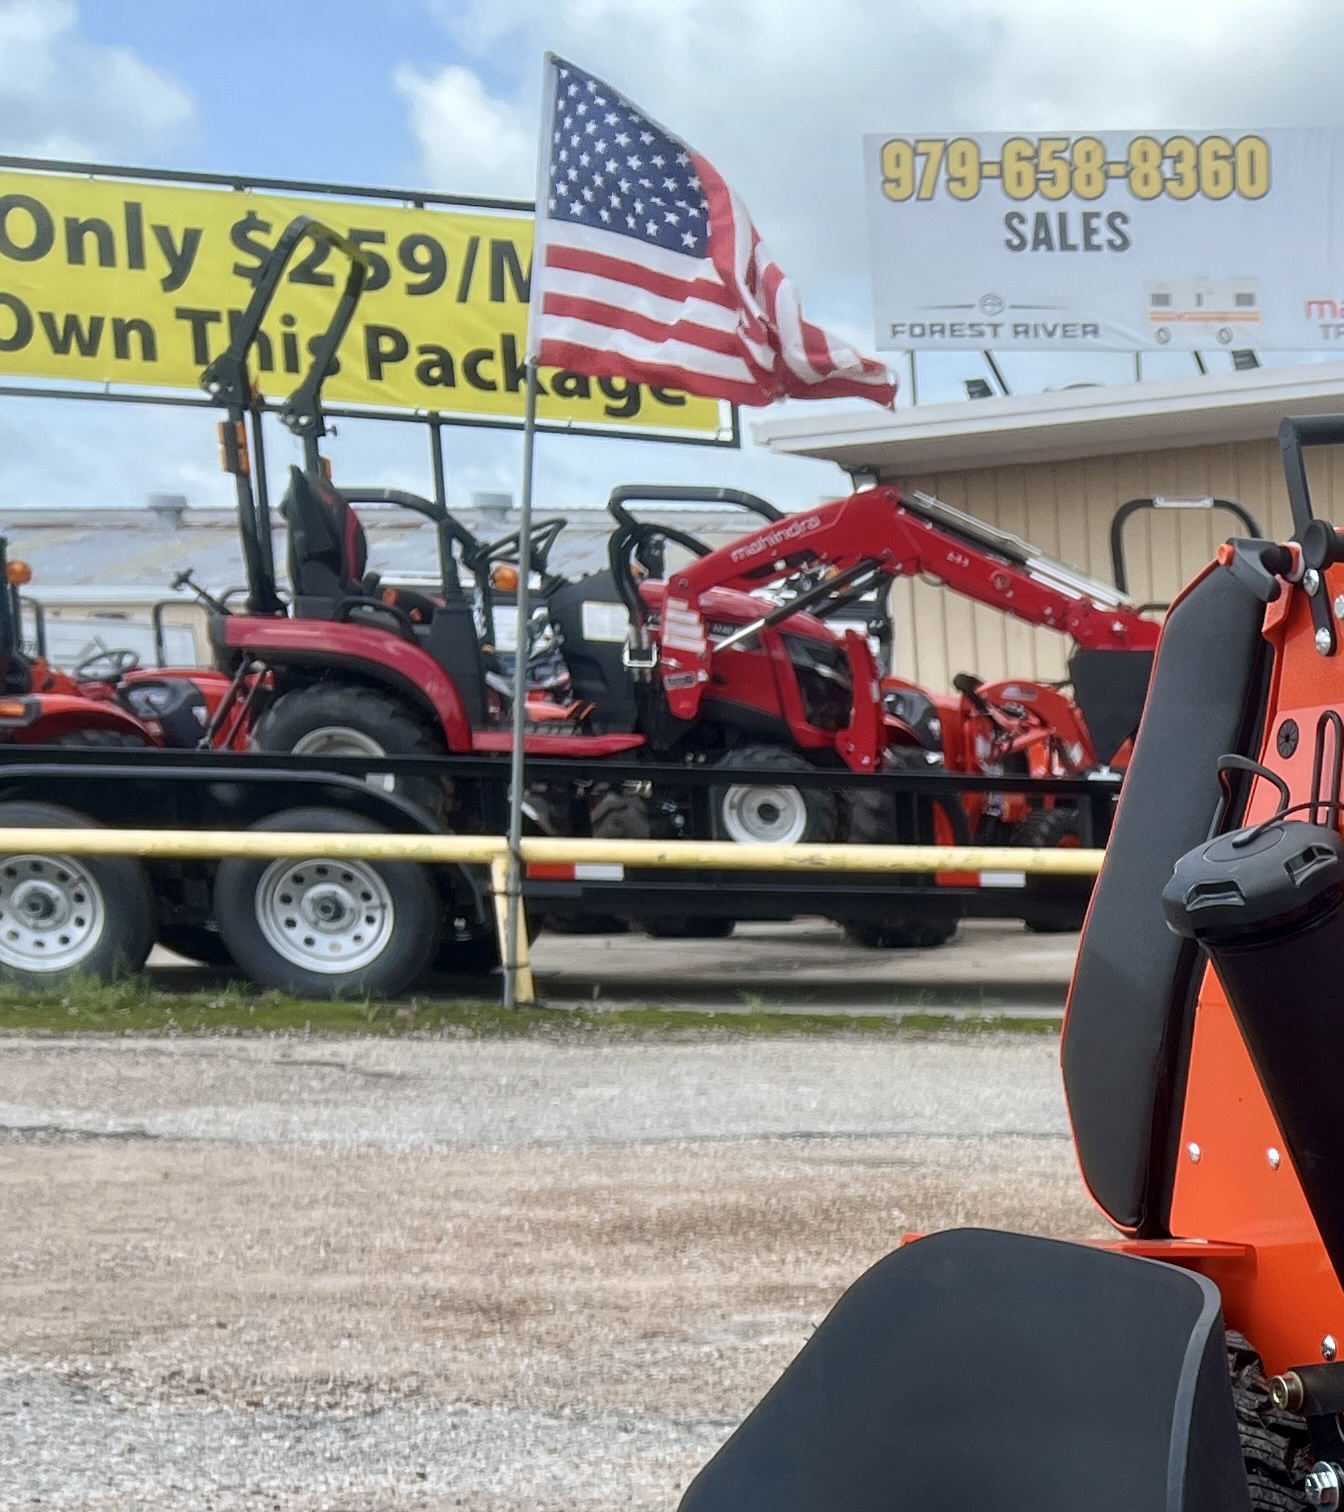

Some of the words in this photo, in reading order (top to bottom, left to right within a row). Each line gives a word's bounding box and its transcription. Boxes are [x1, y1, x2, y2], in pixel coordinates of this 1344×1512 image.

[880, 135, 1272, 202] 979-658-8360
[0, 194, 203, 292] Only
[230, 210, 533, 304] $259/M
[1004, 211, 1131, 252] SALES
[0, 292, 157, 362] Own
[175, 306, 341, 377] This
[890, 322, 1004, 340] FOREST
[1012, 321, 1099, 339] RIVER
[731, 515, 822, 563] mahindra
